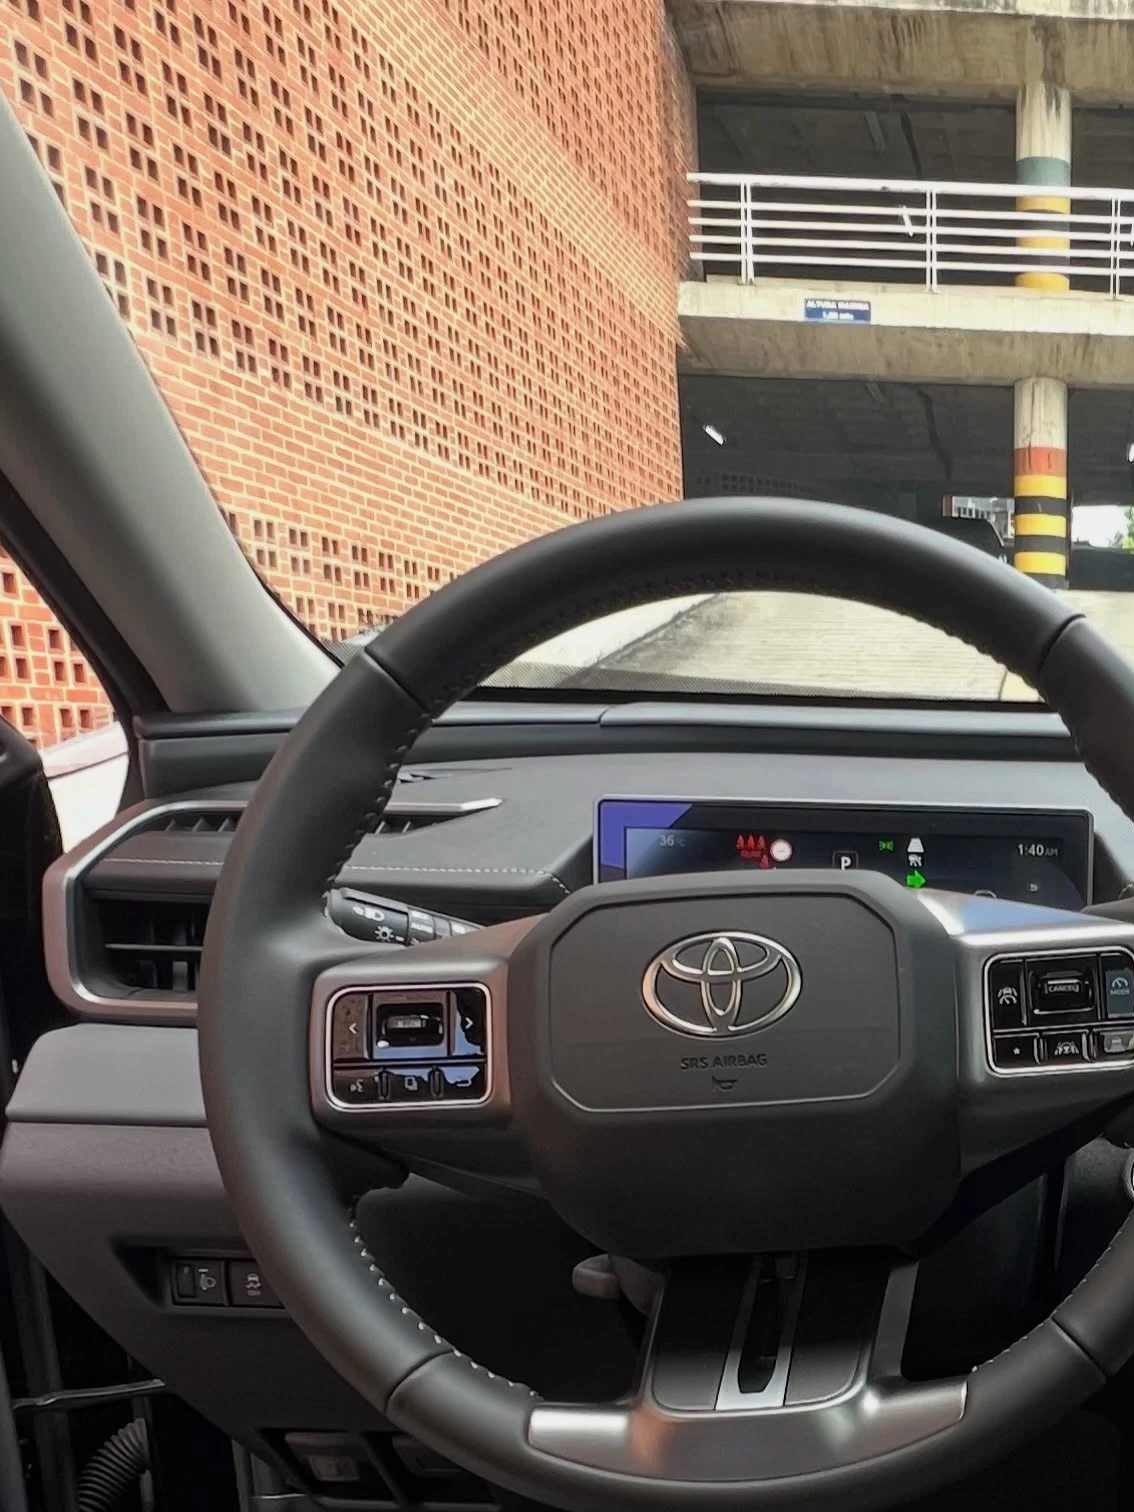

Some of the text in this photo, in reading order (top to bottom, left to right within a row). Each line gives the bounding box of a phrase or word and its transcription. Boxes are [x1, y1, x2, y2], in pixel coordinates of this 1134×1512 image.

[840, 856, 852, 870] P
[680, 1053, 769, 1070] SRS AIRBAG
